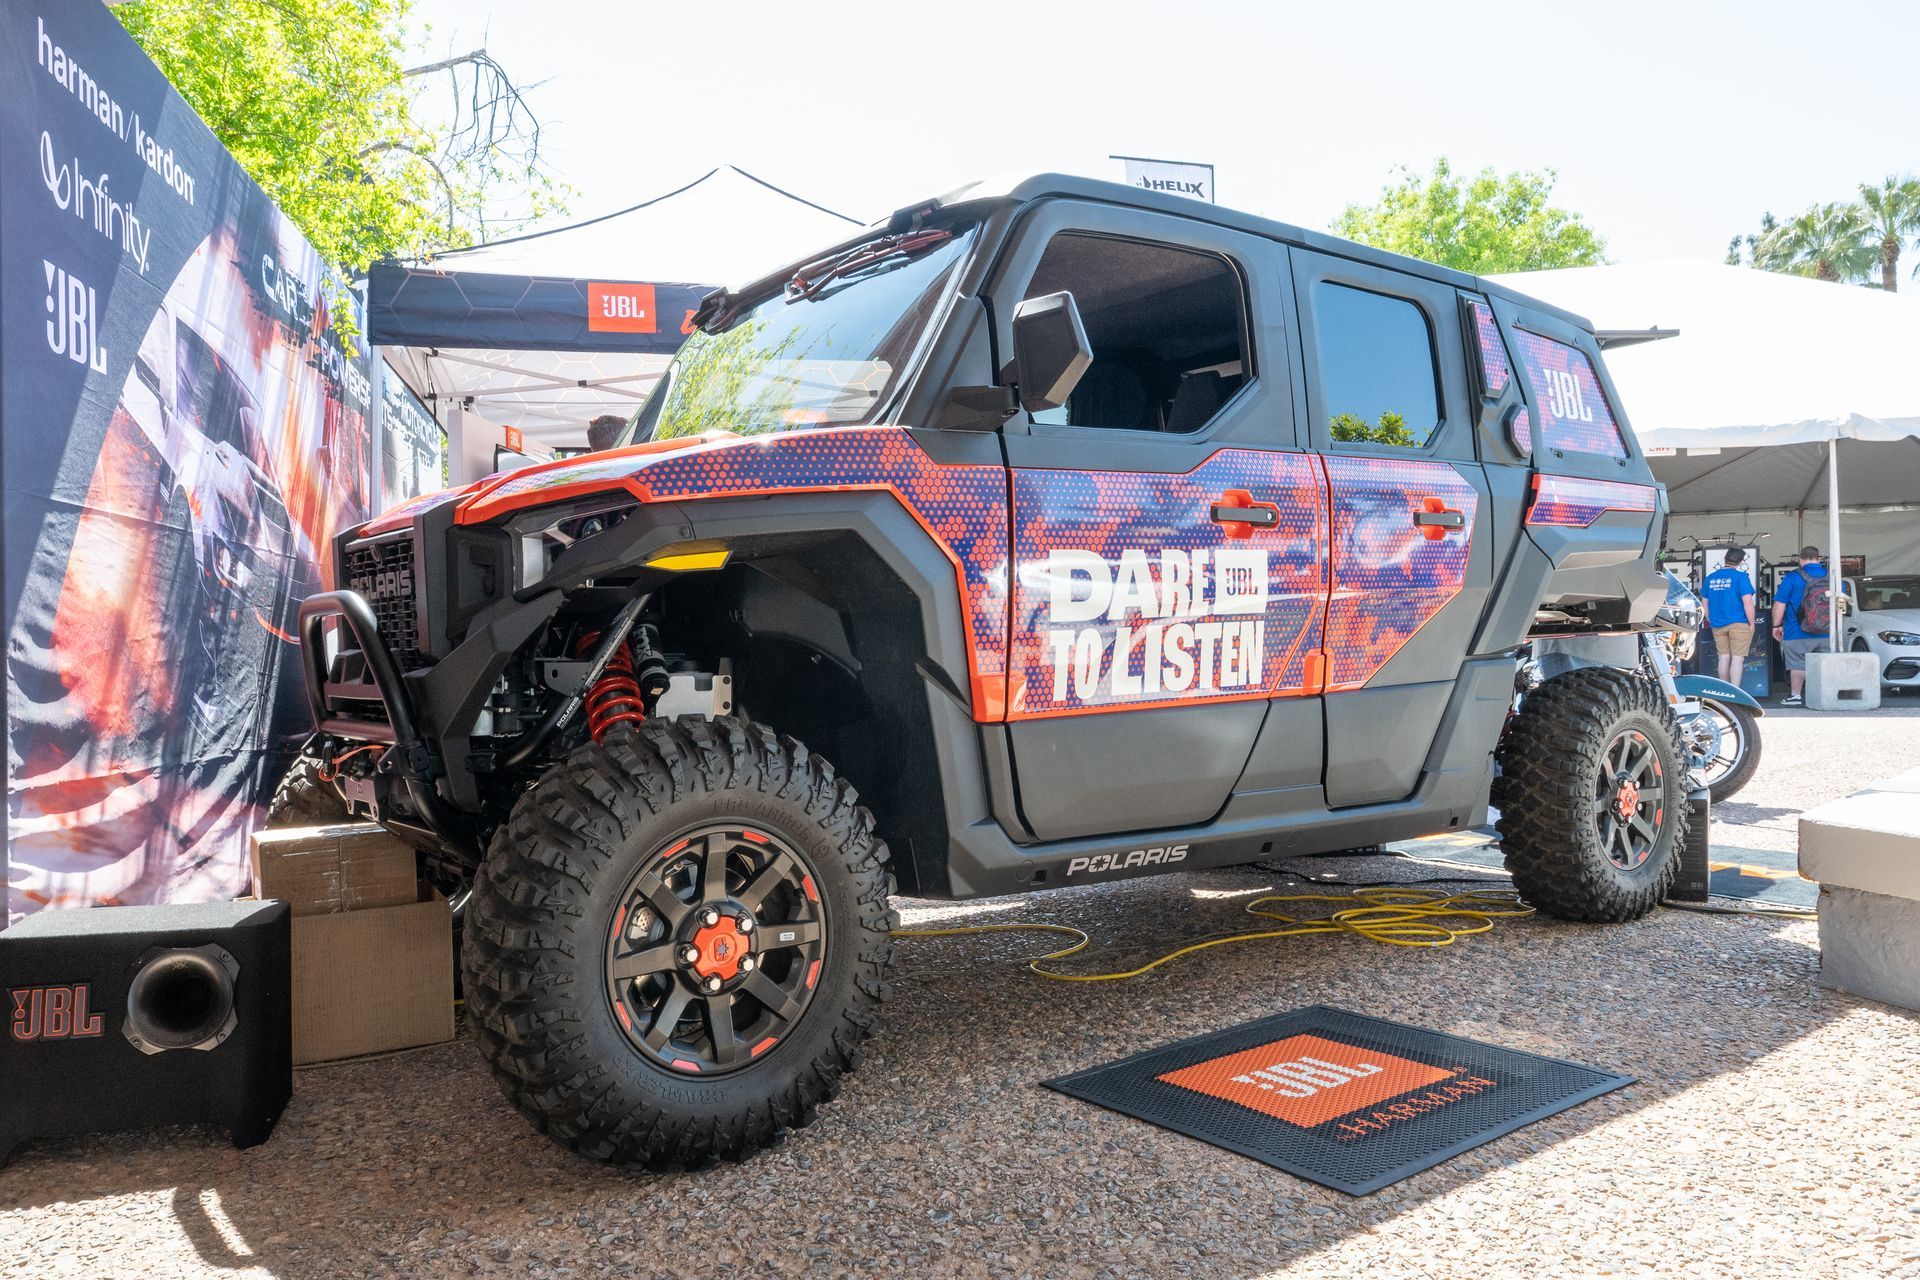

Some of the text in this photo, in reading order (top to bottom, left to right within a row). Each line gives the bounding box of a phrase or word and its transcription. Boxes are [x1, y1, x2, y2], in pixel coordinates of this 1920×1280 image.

[1152, 179, 1205, 198] HELIX
[75, 157, 150, 276] Infinity
[43, 259, 107, 375] JBL
[602, 295, 645, 318] JBL
[1543, 368, 1593, 422] JBL
[350, 569, 412, 600] POLARIS
[1049, 549, 1259, 622] DARE JBL
[1050, 620, 1265, 702] TO LISTEN
[556, 696, 580, 728] POLARIS
[1066, 844, 1190, 876] POLARIS
[12, 986, 101, 1039] JBL
[1230, 1056, 1384, 1098] JBL
[1338, 1076, 1498, 1135] HARMAN
